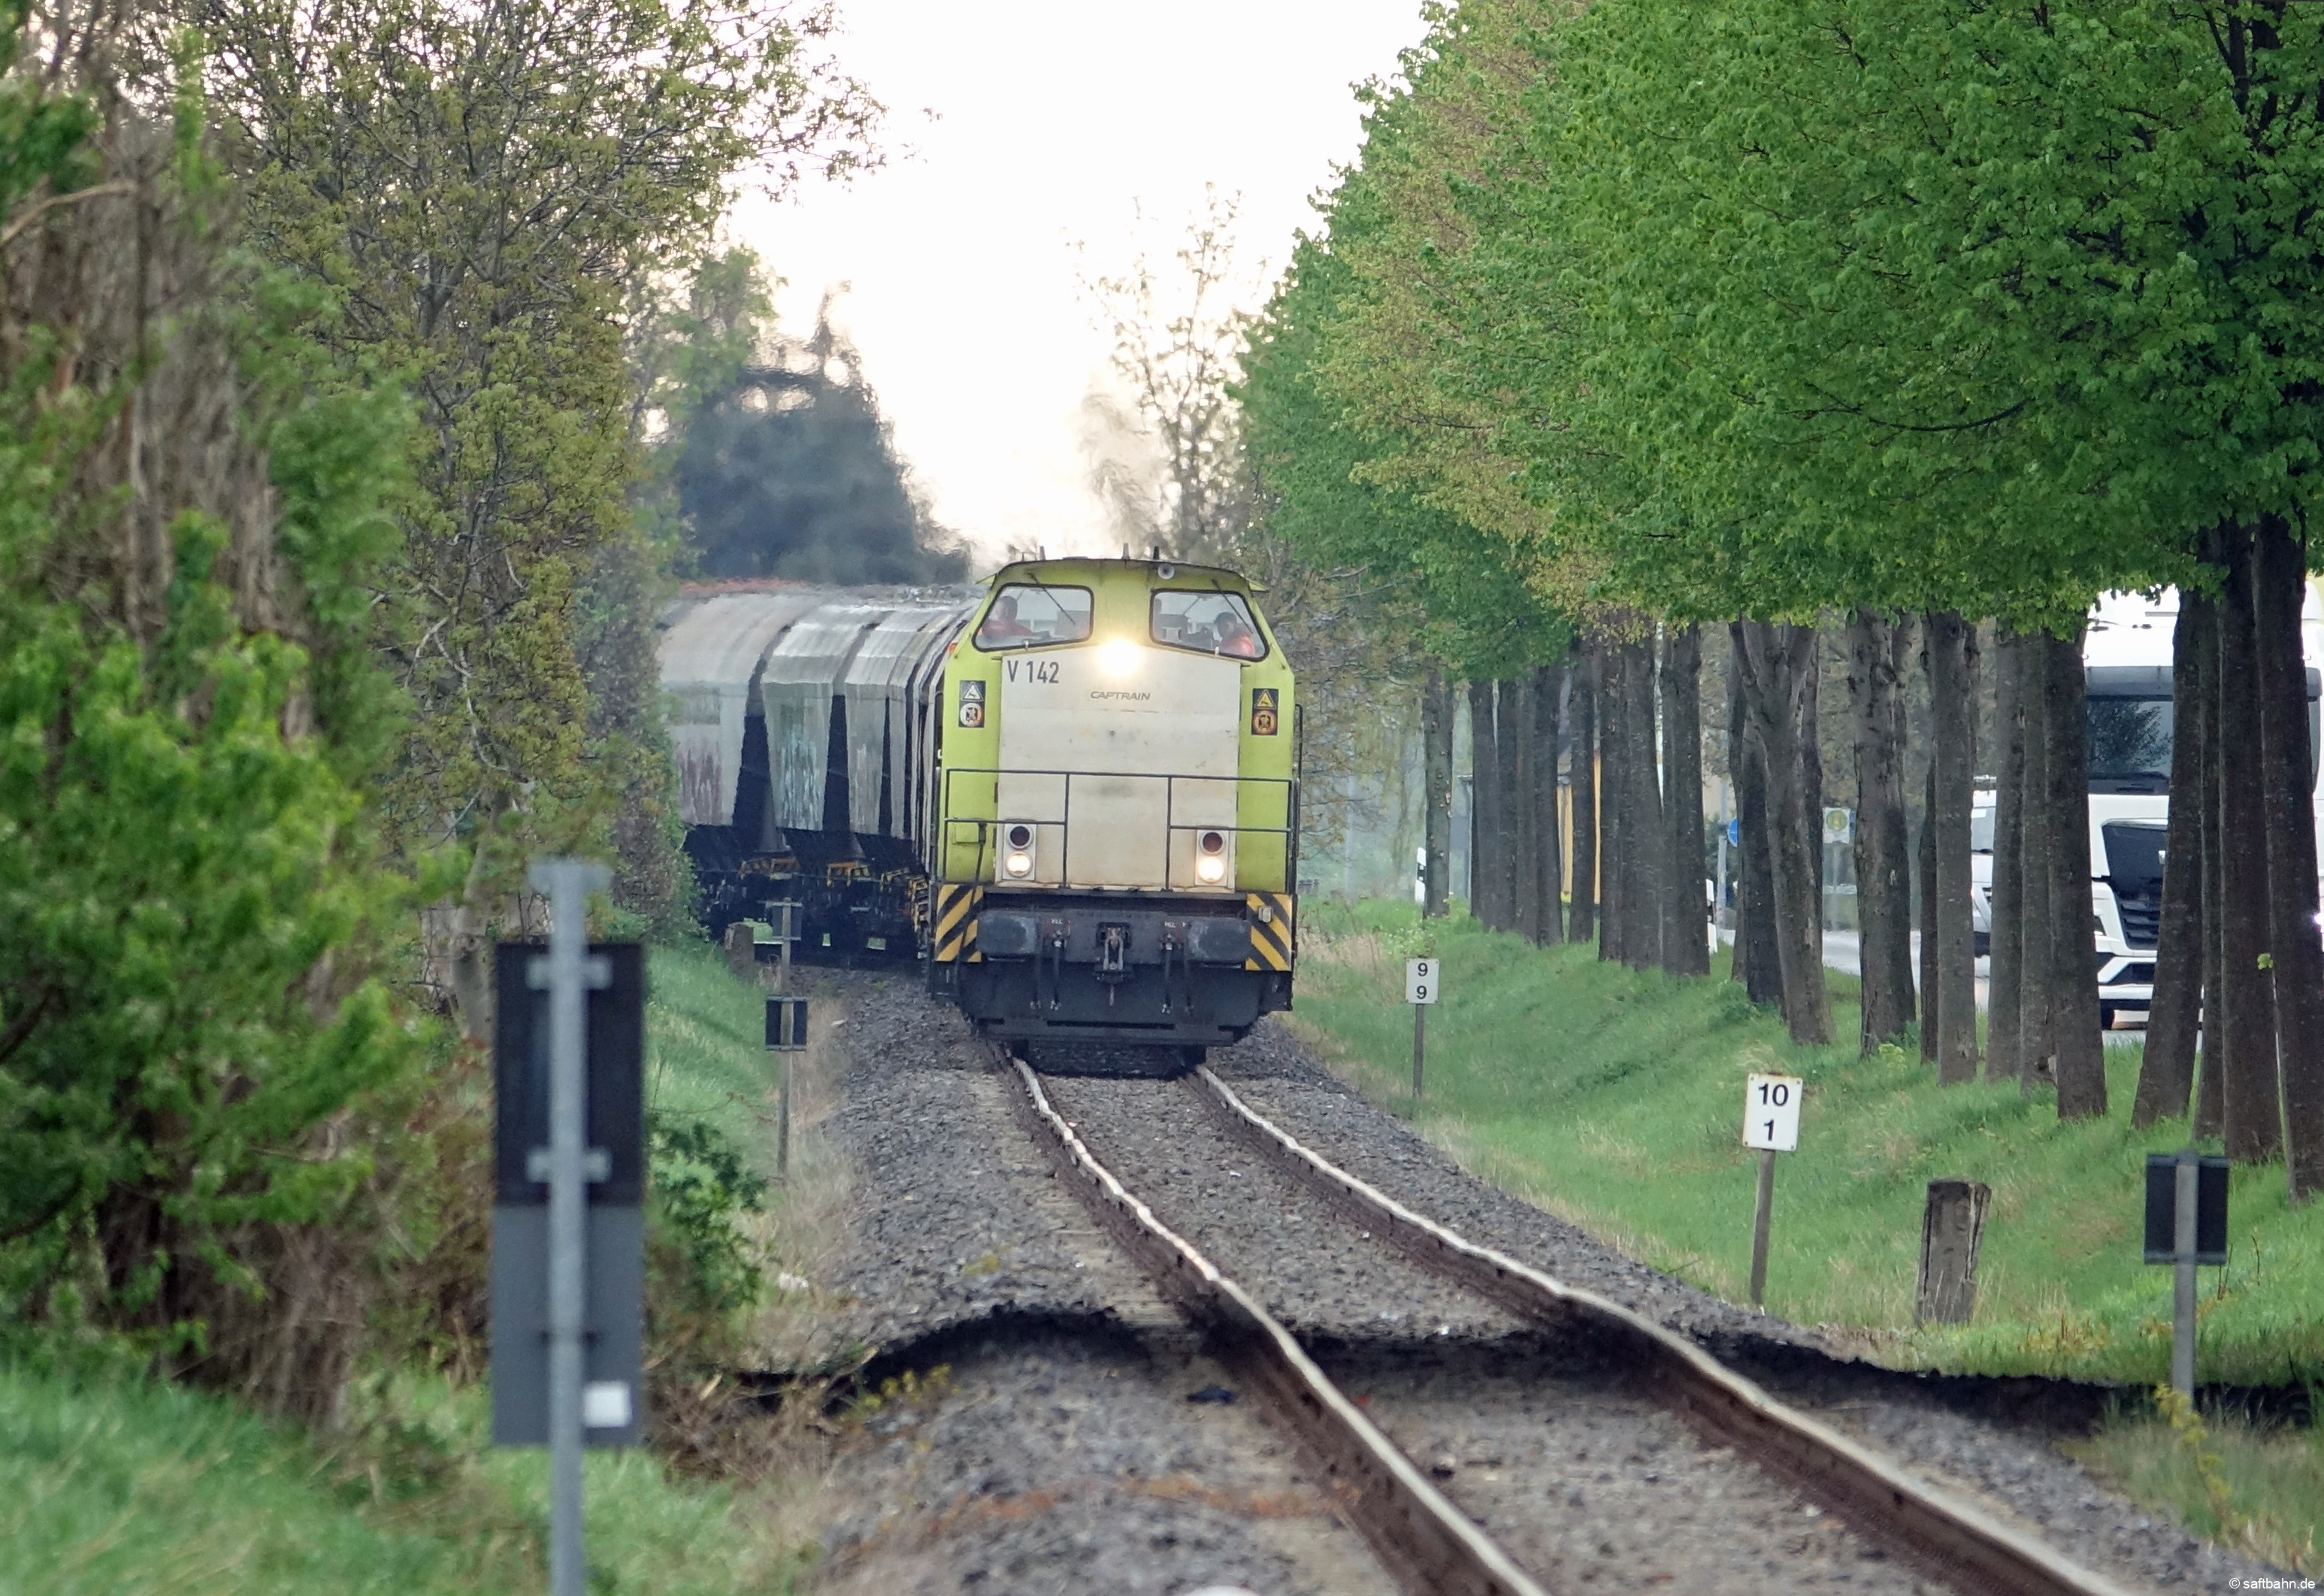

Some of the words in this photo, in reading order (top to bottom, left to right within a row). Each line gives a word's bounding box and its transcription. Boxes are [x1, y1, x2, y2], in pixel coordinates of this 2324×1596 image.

[1007, 660, 1018, 683] V
[1026, 661, 1060, 683] 142
[1090, 691, 1151, 701] CAPTRAIN
[1418, 962, 1428, 977] 9
[1416, 985, 1427, 1000] 9
[1758, 1083, 1789, 1107] 10
[1763, 1119, 1774, 1141] 1
